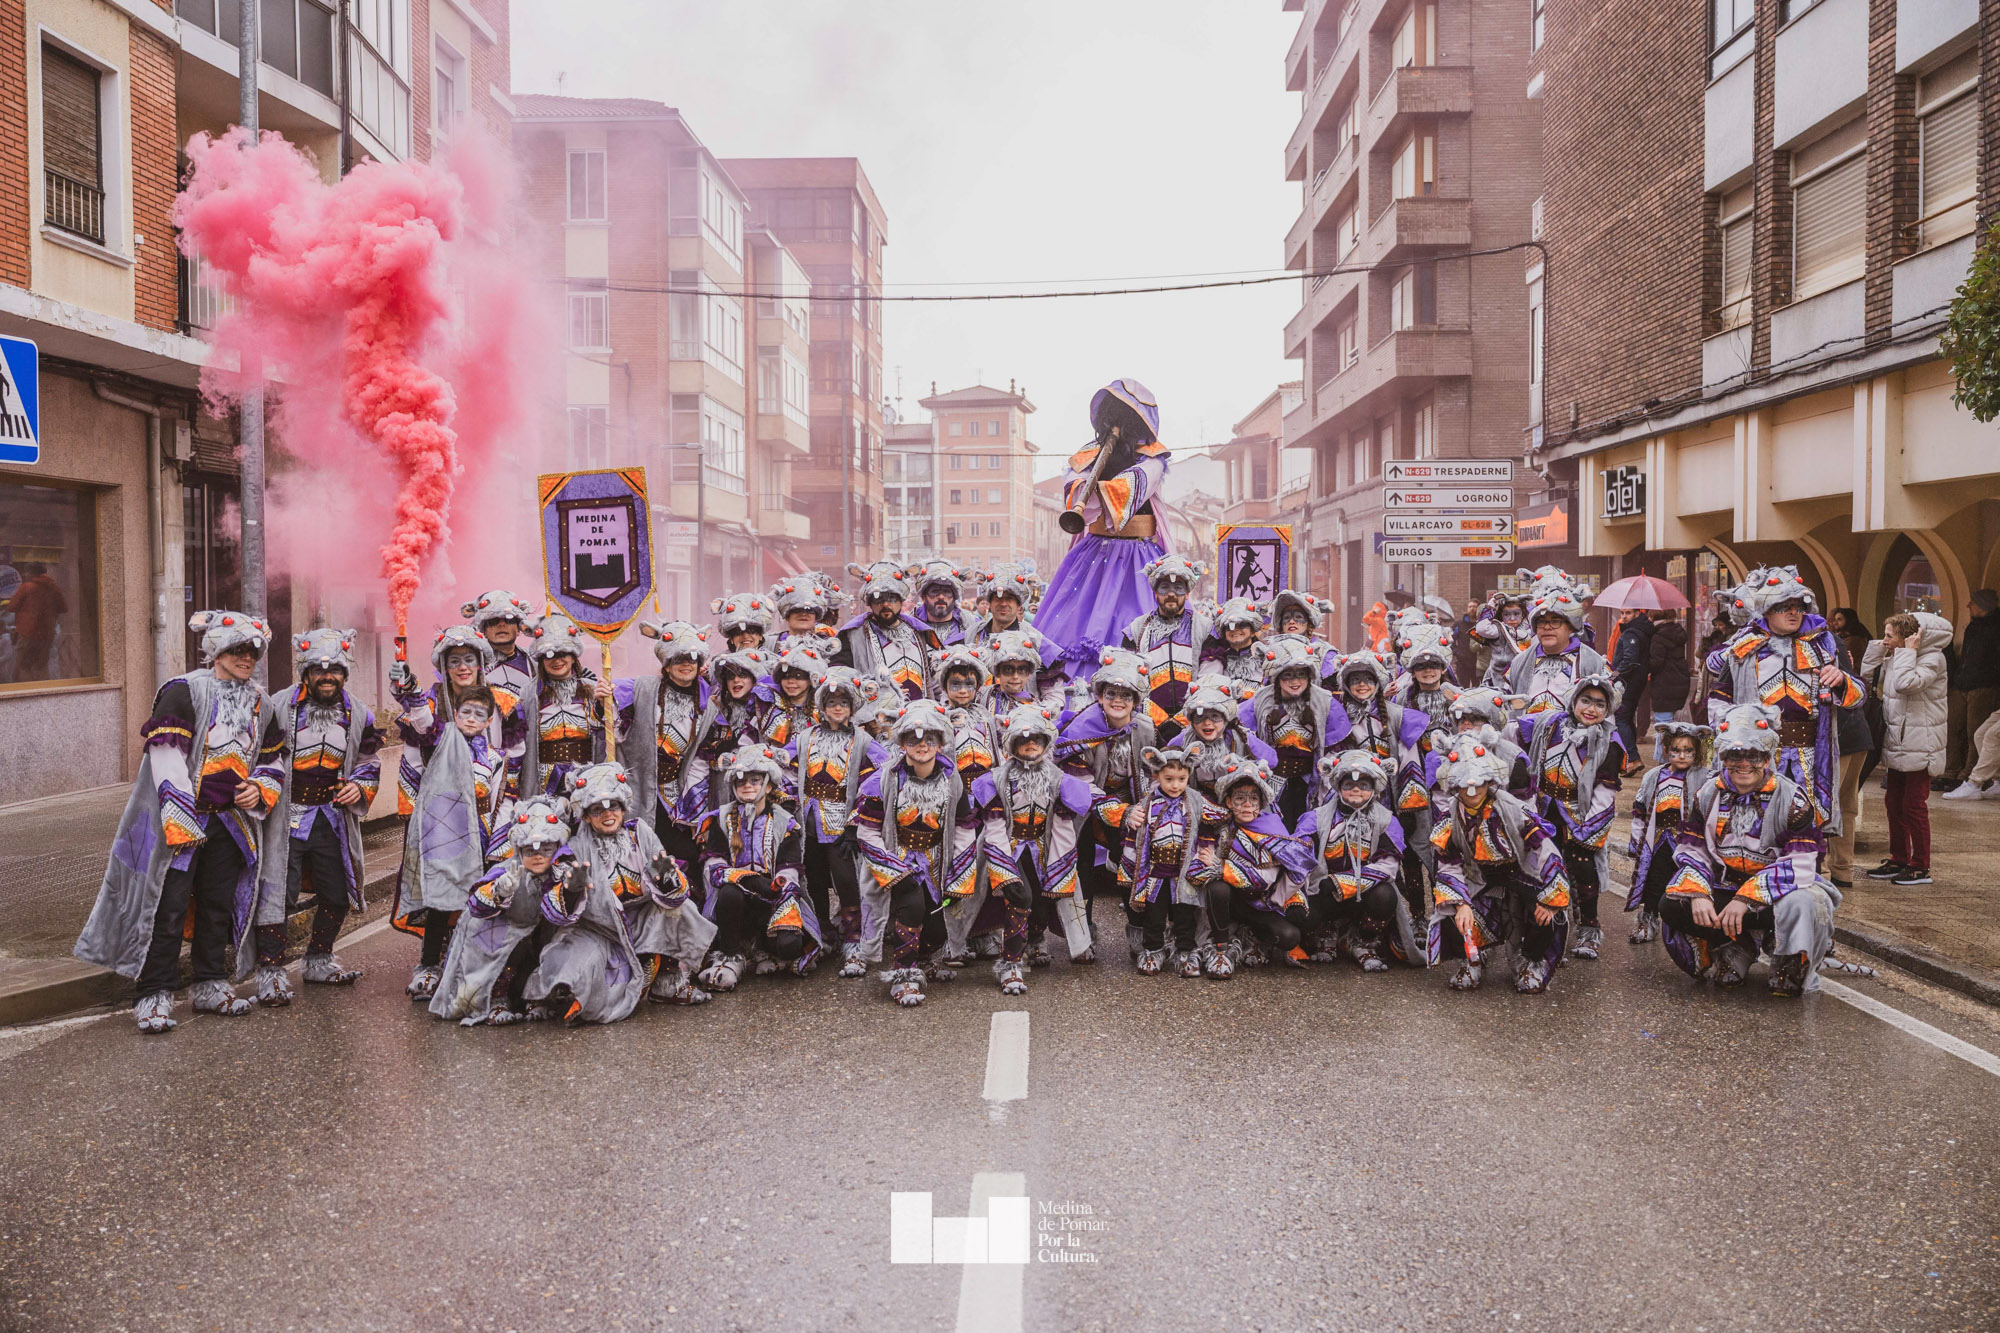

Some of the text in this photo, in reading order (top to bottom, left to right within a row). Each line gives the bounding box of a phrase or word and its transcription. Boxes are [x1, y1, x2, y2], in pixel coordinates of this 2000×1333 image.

[1405, 467, 1508, 476] N-629 TRESPADERNE
[1405, 493, 1508, 503] N-629 LOGROÑO
[576, 514, 616, 524] MEDINA
[591, 526, 604, 534] DE
[1389, 521, 1453, 530] VILLARCAYO
[580, 538, 616, 547] POMAR
[1389, 548, 1433, 557] BURGOS
